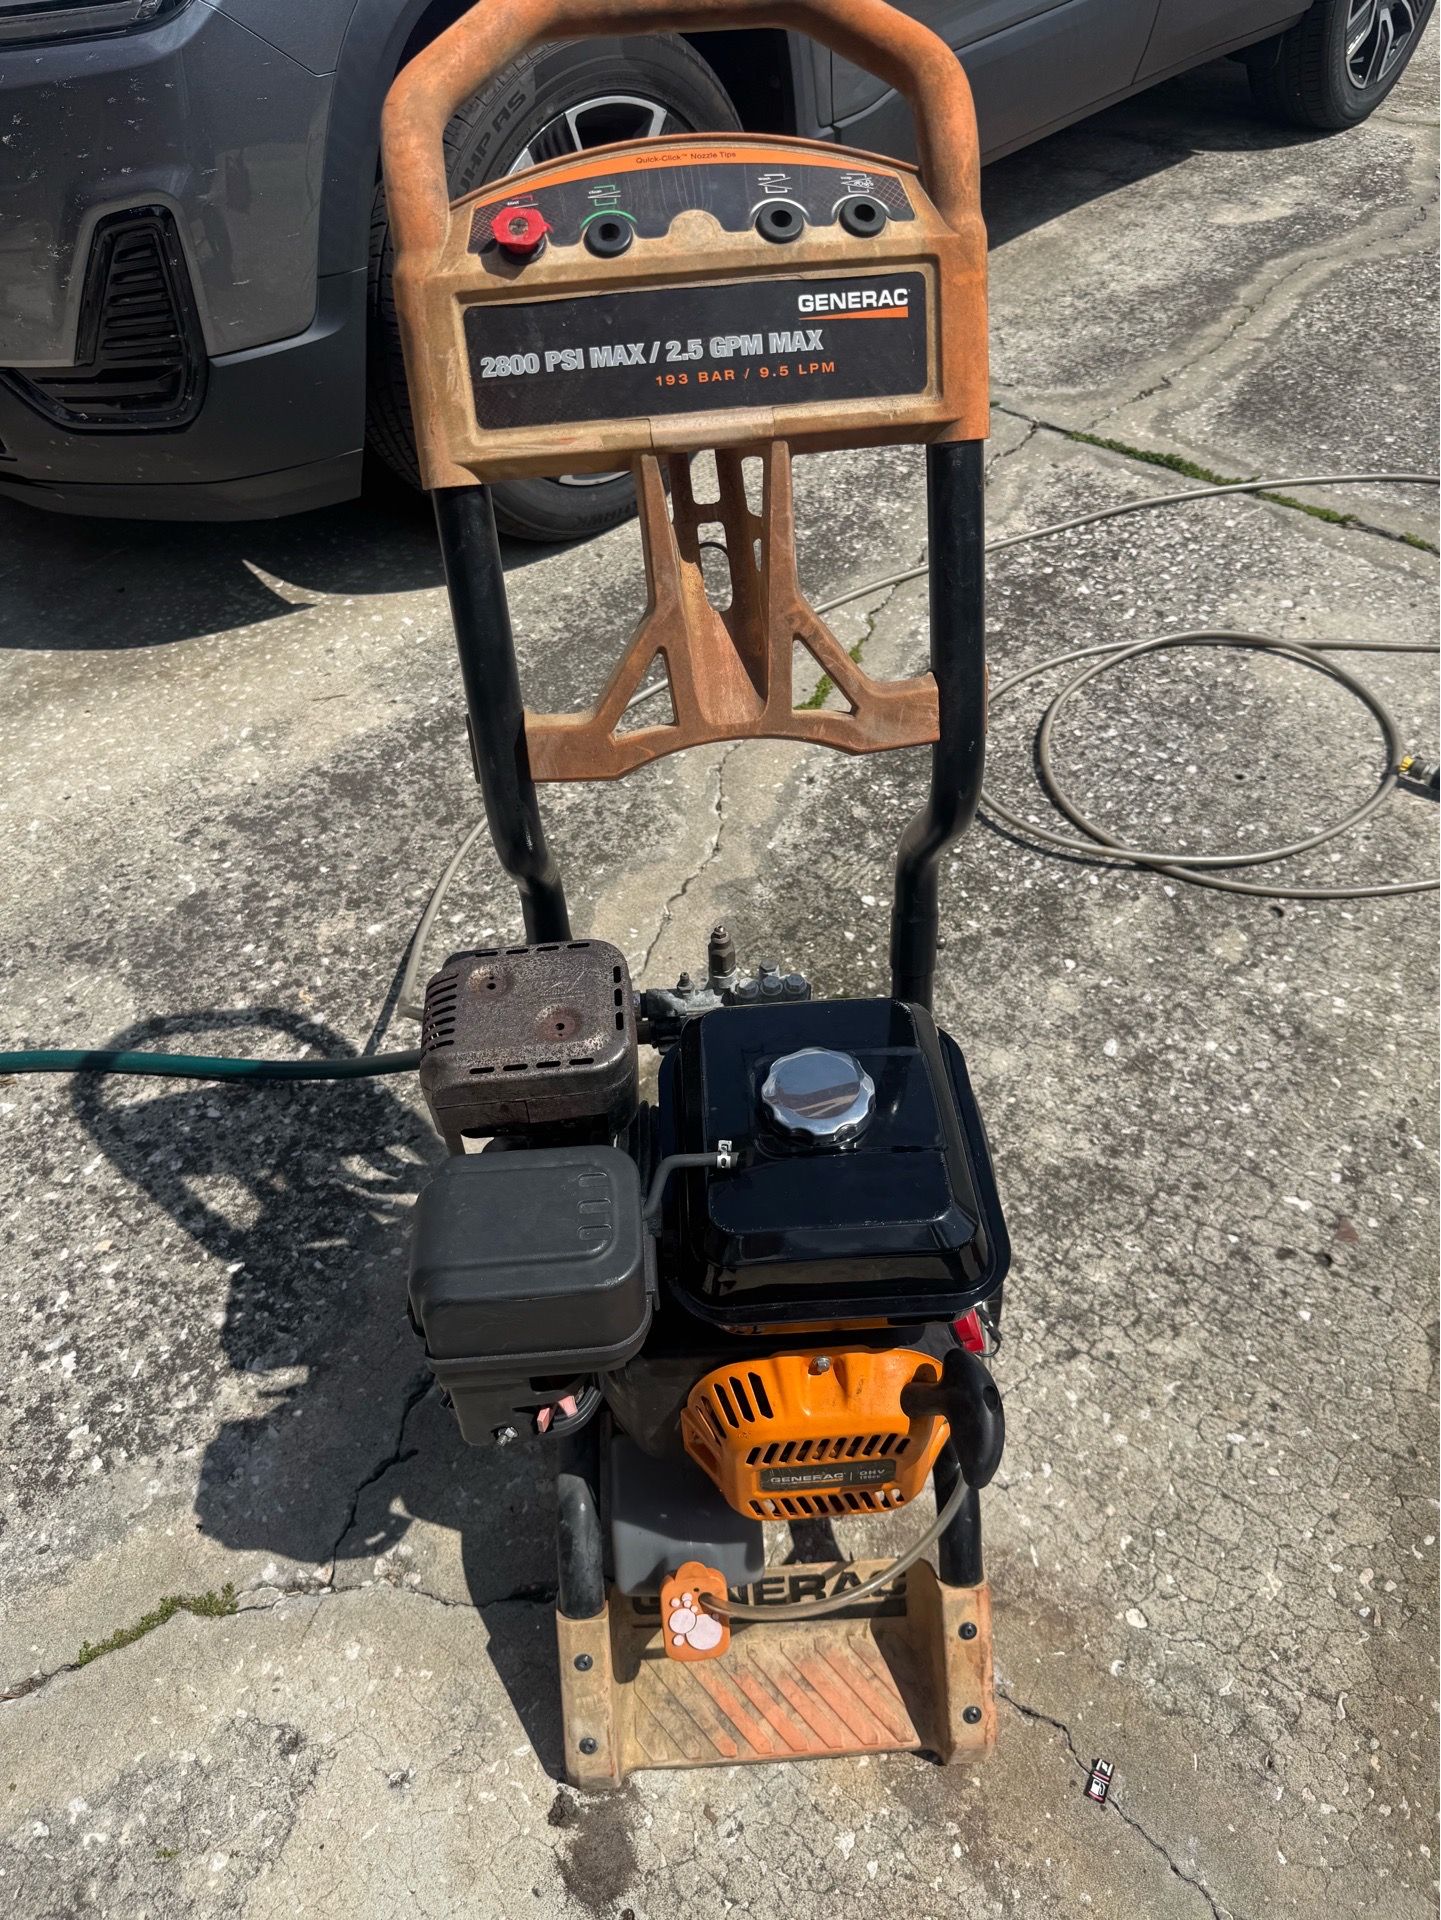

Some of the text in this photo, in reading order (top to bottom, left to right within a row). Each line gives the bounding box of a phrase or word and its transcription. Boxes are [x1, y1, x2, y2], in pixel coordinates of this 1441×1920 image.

[492, 90, 527, 133] AS
[690, 152, 718, 160] Nozzle
[719, 151, 737, 159] Tips
[798, 288, 908, 313] GENERAC
[480, 328, 825, 379] 2800 PSI MAX / 2.5 GPM MAX
[655, 361, 836, 387] 193 BAR / 9.5 LPM
[770, 1472, 844, 1483] GENERAC
